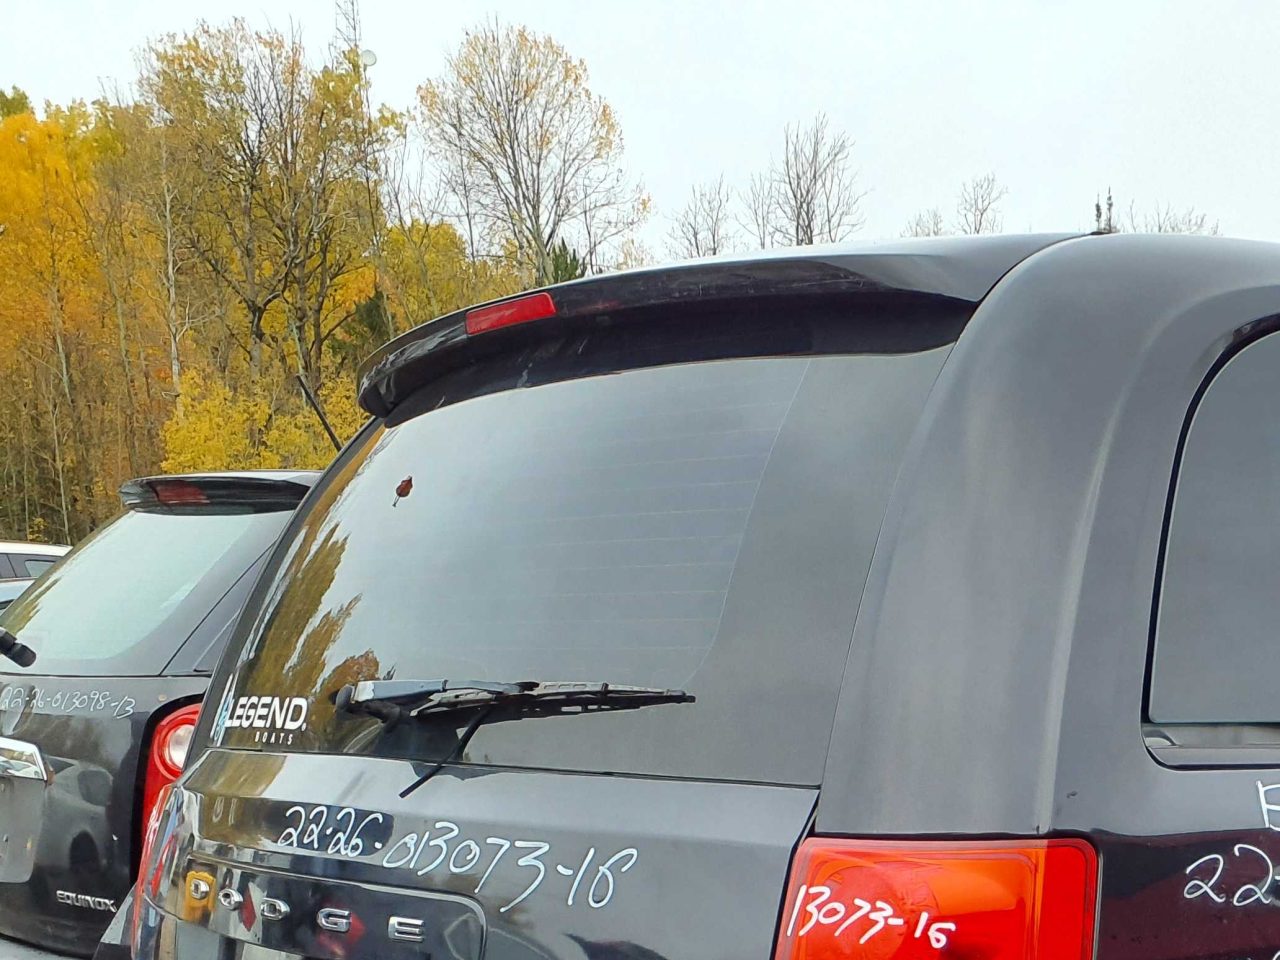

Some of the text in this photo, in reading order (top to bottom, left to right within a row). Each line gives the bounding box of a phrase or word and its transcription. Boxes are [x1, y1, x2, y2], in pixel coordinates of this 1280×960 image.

[255, 731, 293, 745] BOATS
[56, 890, 118, 913] EQUINOX
[191, 879, 425, 942] DODGE
